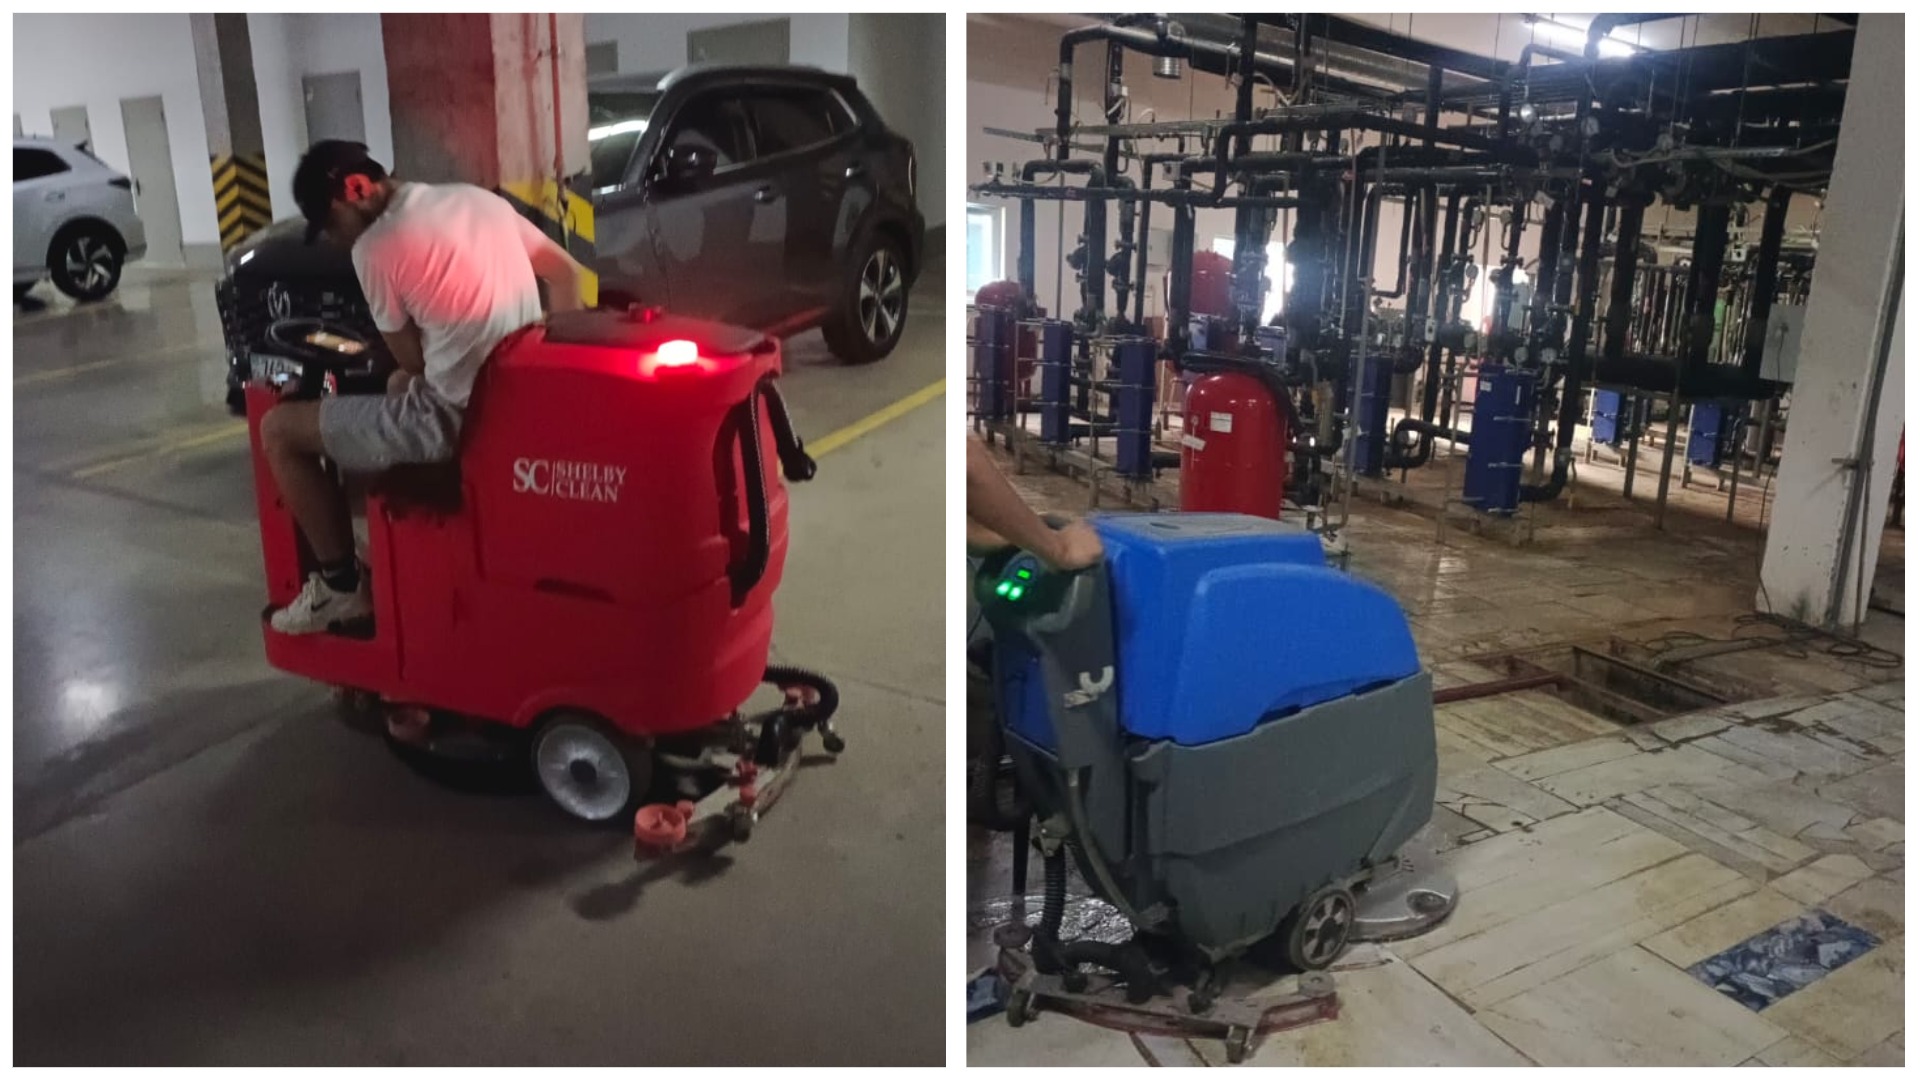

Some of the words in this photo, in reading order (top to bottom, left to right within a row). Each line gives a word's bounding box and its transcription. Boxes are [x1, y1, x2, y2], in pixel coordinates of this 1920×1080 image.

[513, 457, 549, 494] SC
[556, 460, 627, 485] SHELBY
[555, 481, 618, 503] CLEAN
